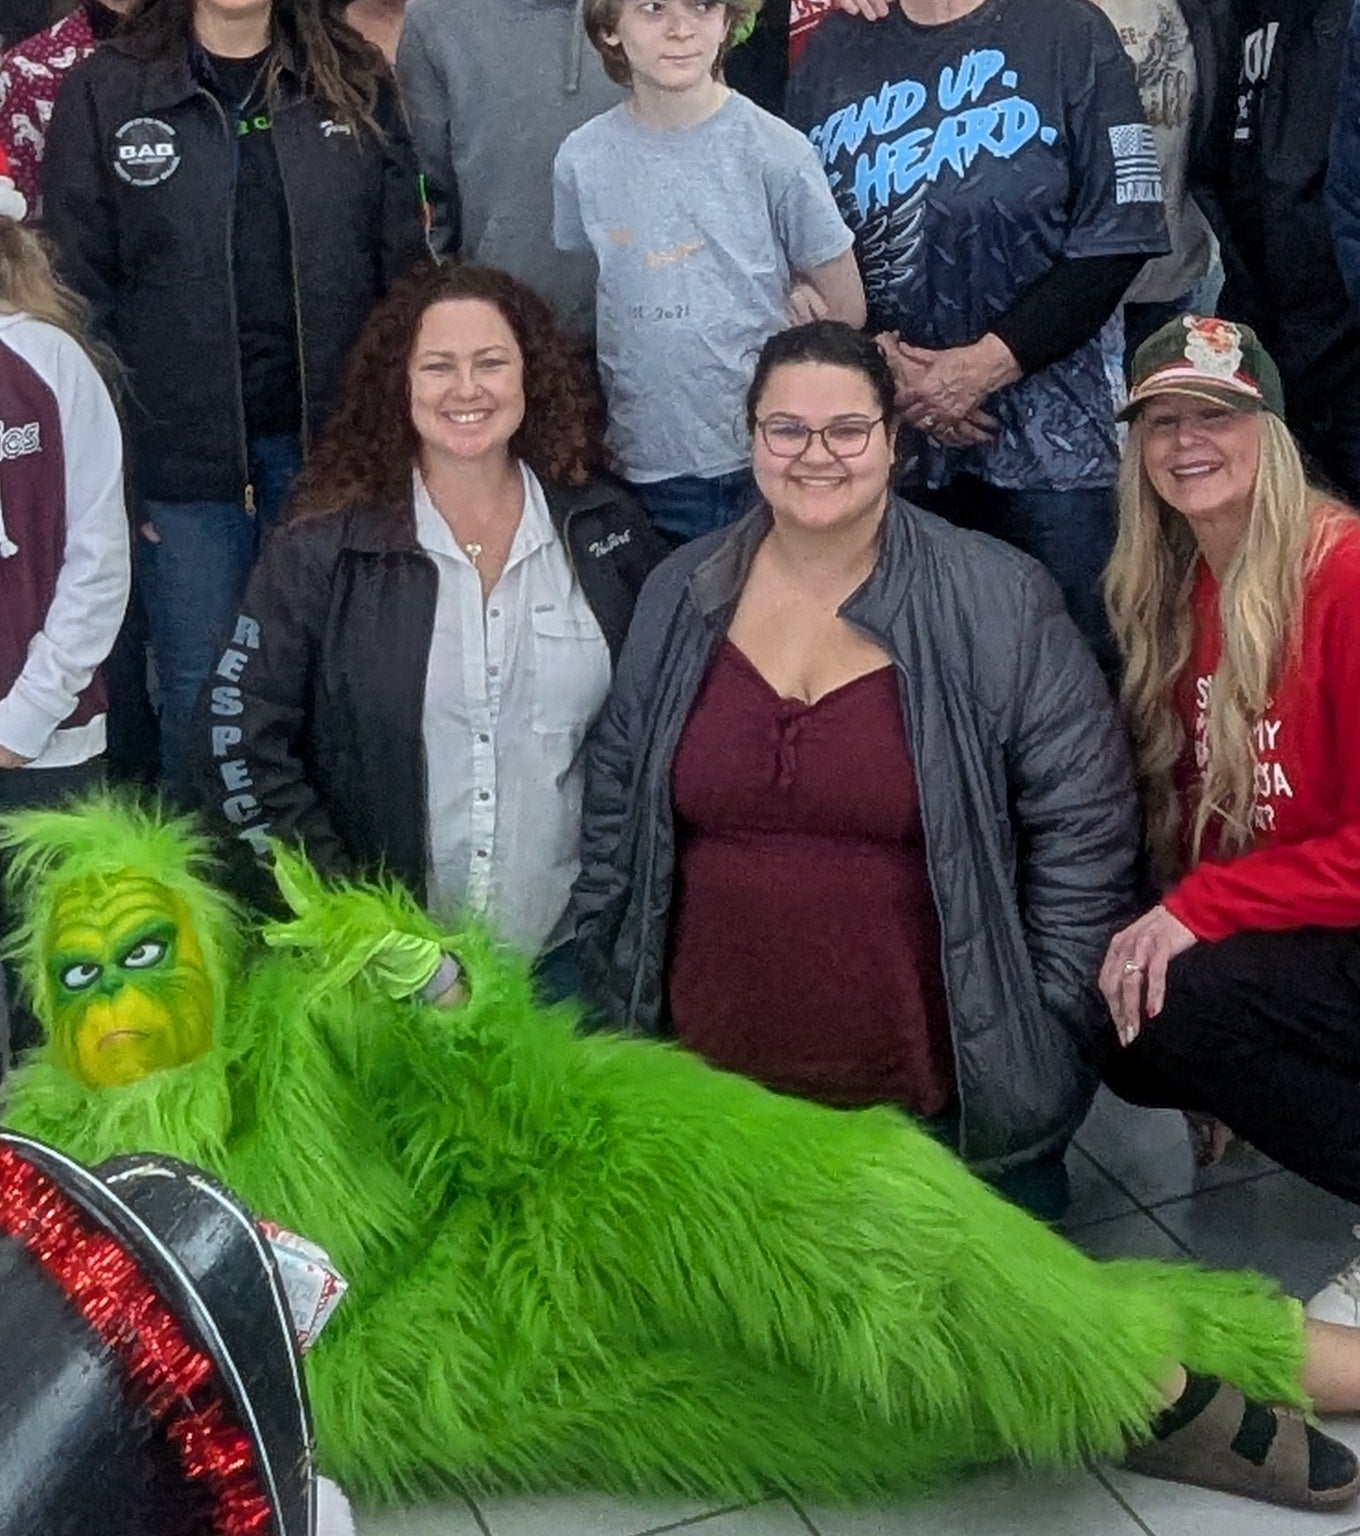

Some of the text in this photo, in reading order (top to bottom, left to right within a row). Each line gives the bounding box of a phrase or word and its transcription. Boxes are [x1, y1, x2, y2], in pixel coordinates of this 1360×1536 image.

[809, 48, 1018, 165] TAND UP.
[849, 95, 1058, 223] HEARD.
[211, 614, 271, 855] RESPECT
